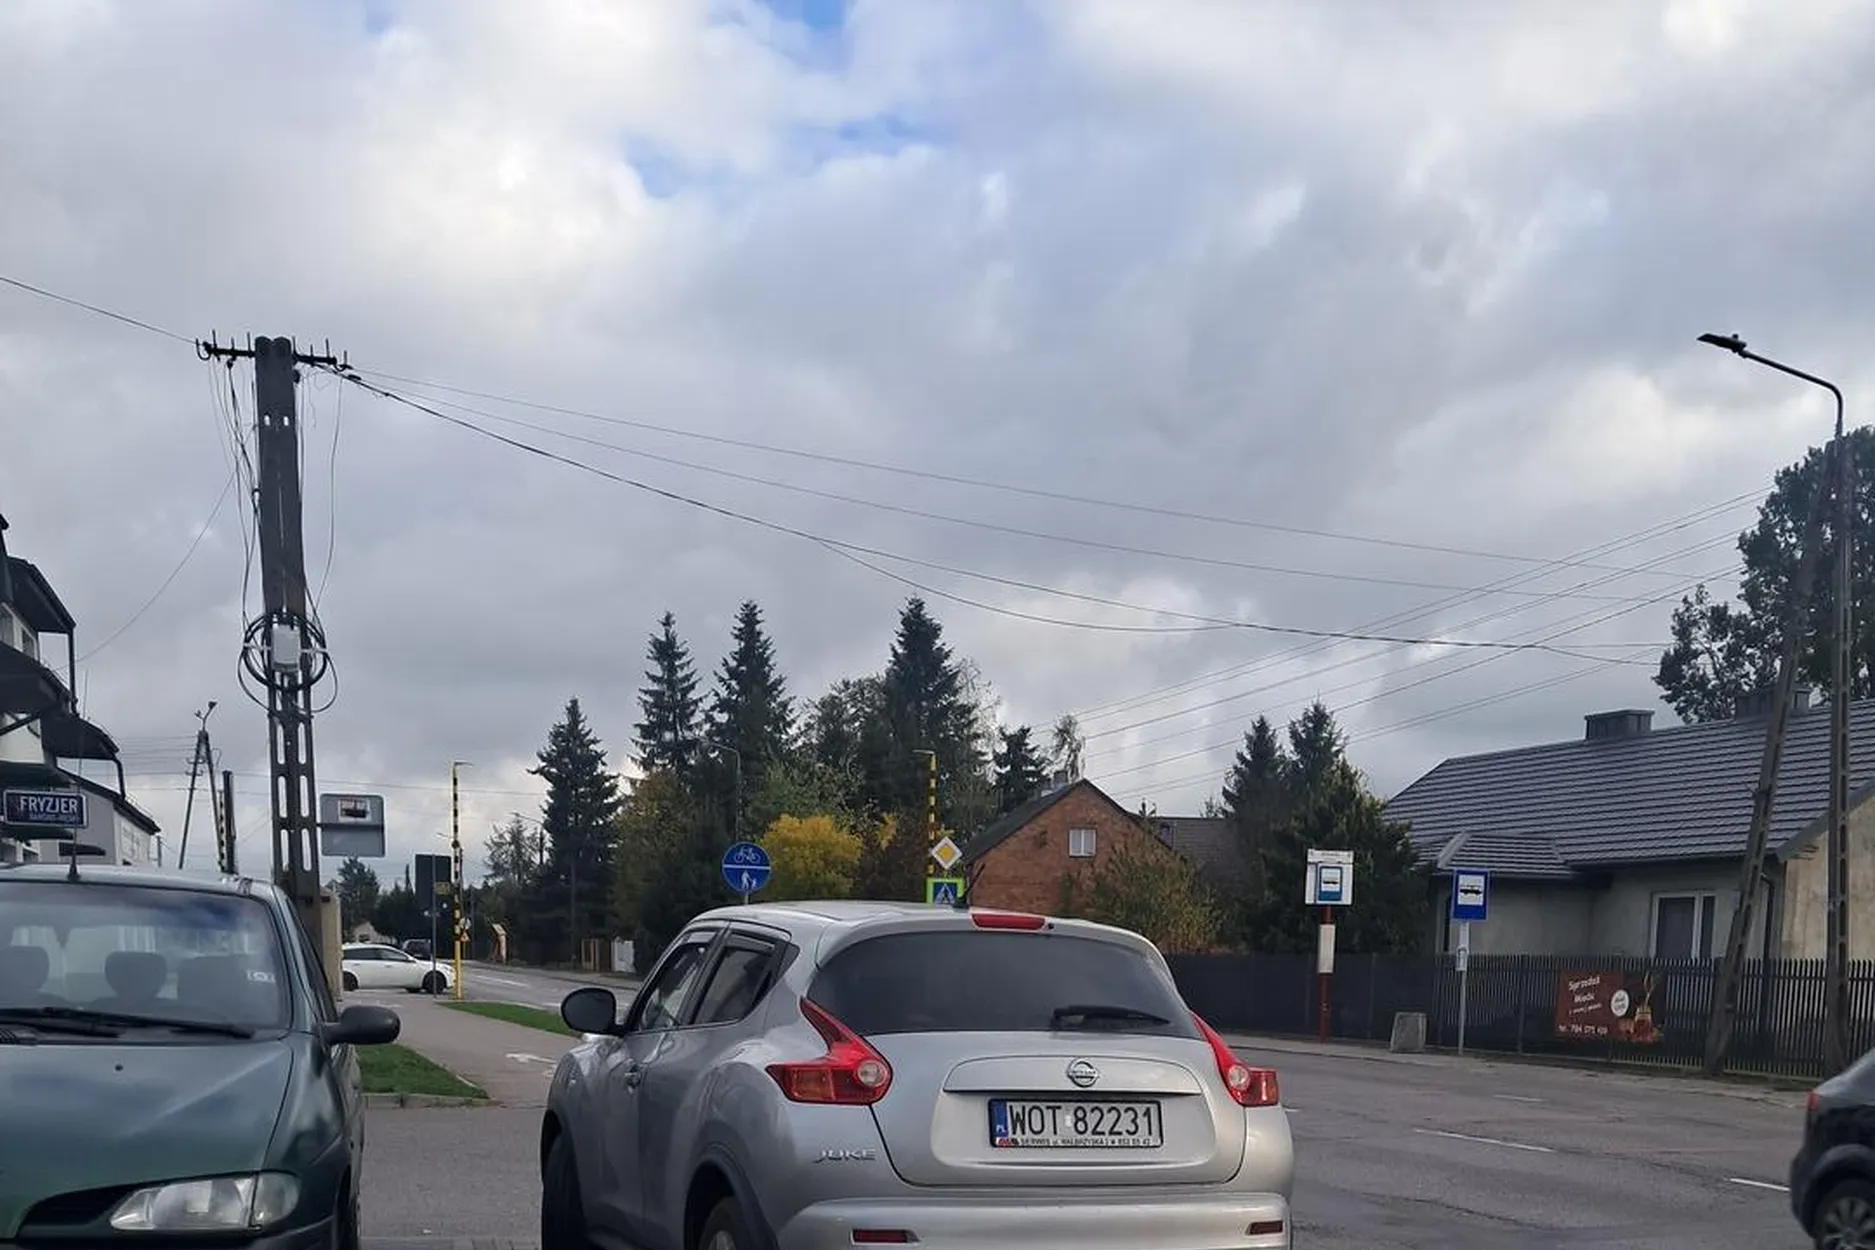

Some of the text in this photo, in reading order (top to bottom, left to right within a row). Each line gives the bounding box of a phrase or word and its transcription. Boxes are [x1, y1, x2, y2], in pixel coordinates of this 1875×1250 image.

[20, 796, 78, 814] FRYZJER
[1009, 1105, 1153, 1136] WOT 82231
[812, 1149, 876, 1163] JUKE
